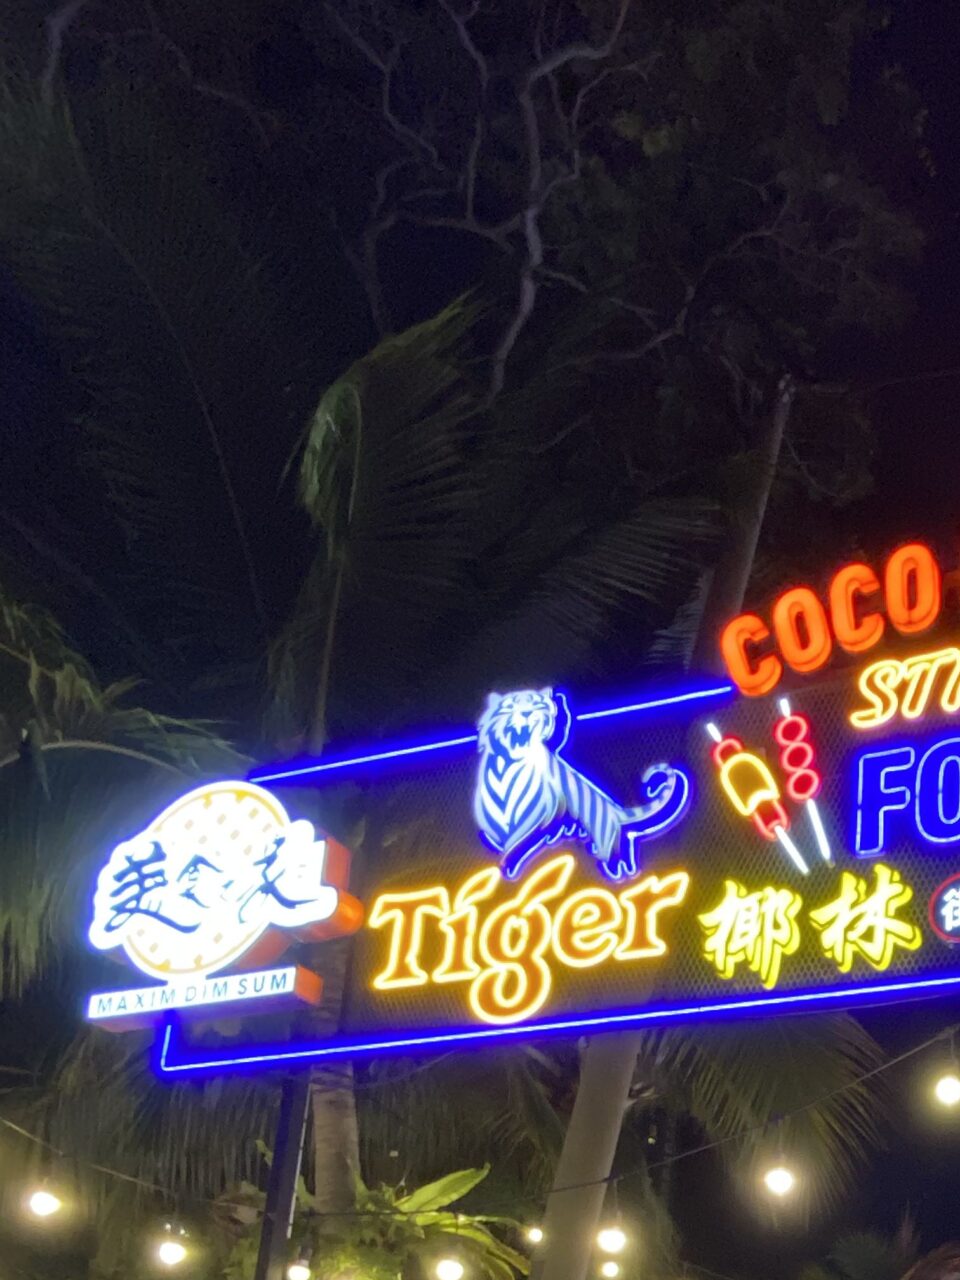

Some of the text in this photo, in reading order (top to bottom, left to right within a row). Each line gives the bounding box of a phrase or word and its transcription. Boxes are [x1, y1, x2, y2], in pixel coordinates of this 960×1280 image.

[721, 544, 940, 696] COCO
[97, 973, 288, 1014] MAXIM DIM SUM
[369, 855, 690, 1024] Tiger
[698, 864, 922, 989] 椰林
